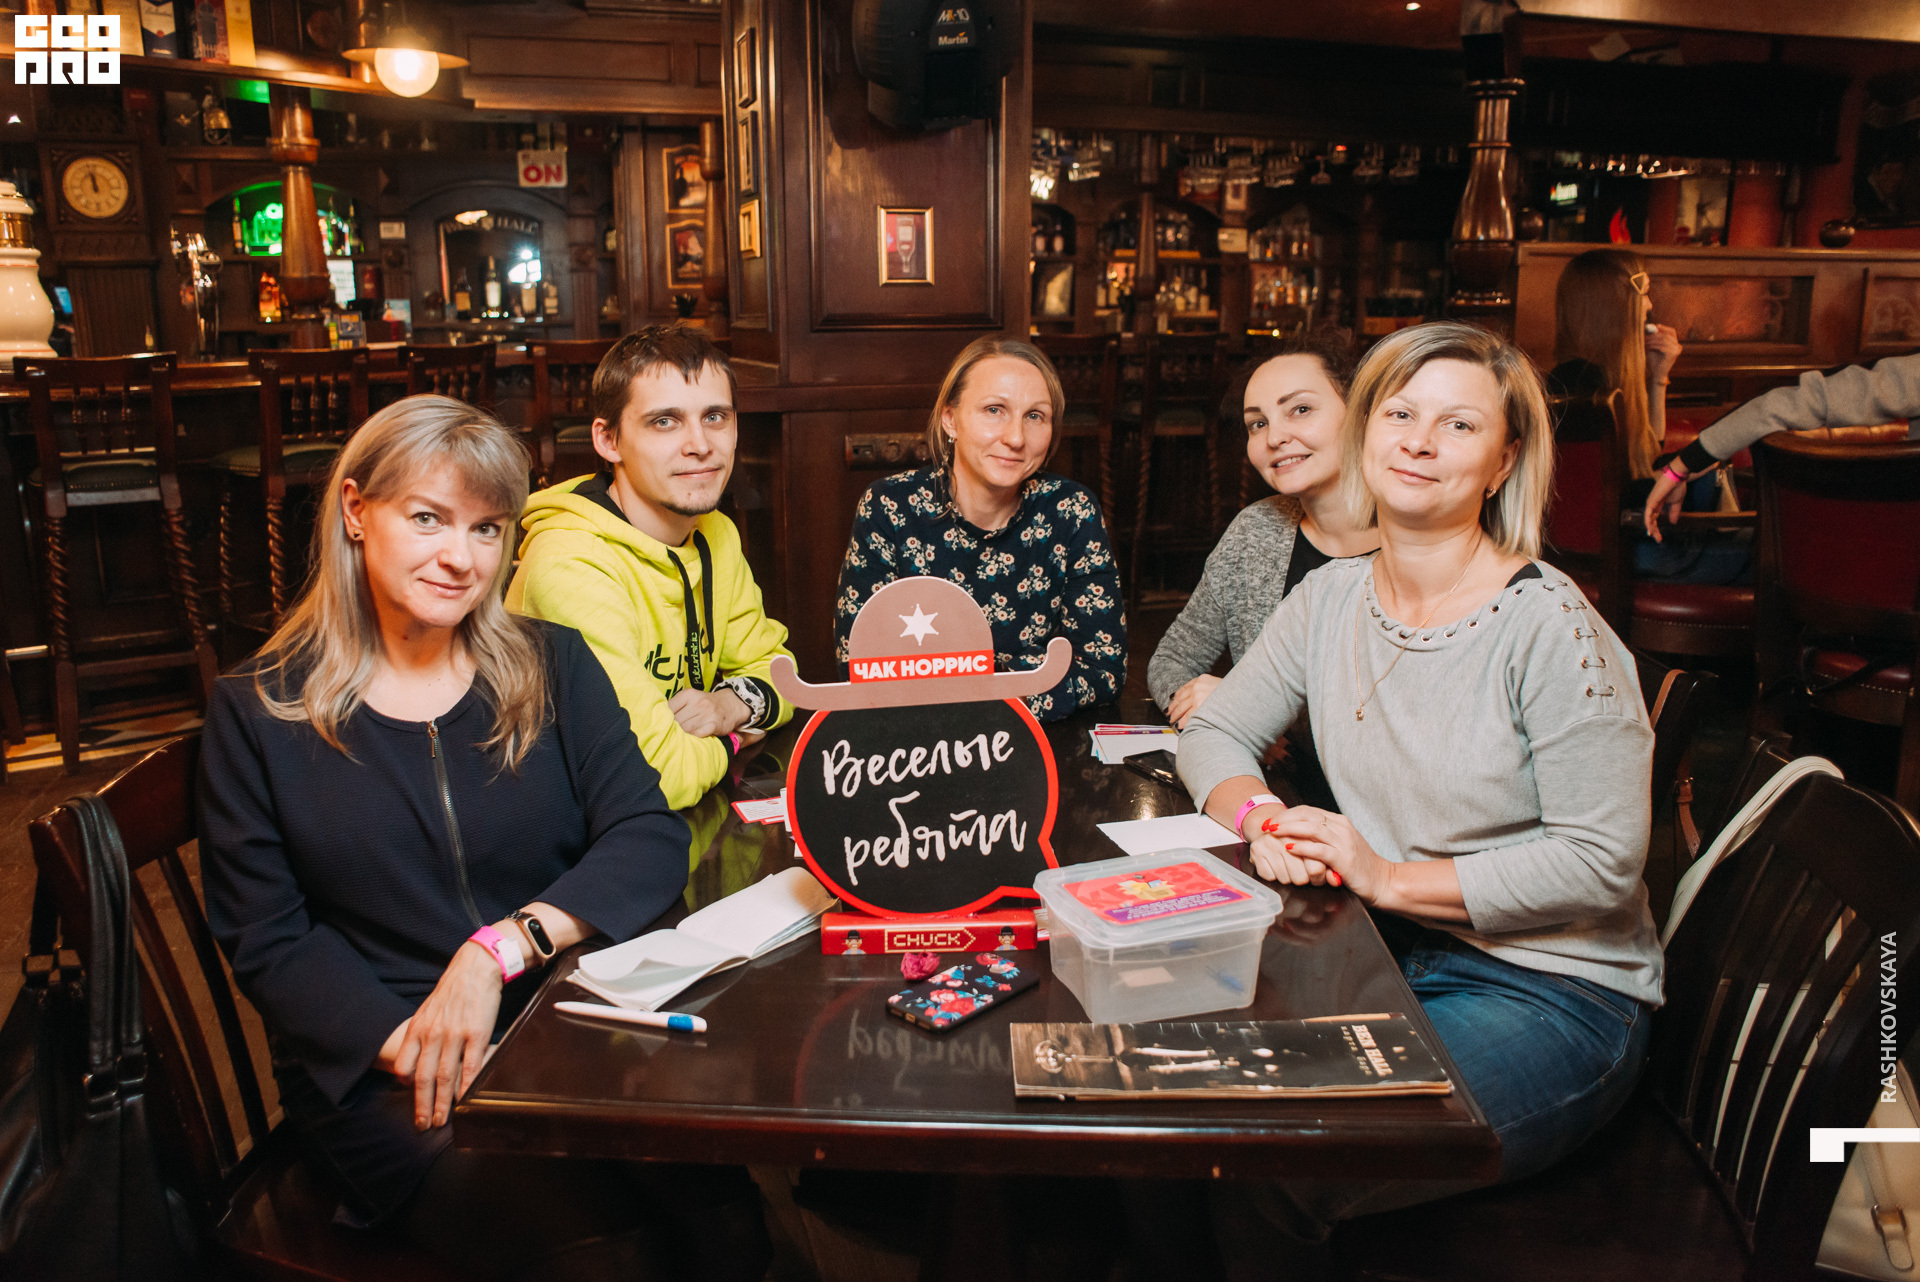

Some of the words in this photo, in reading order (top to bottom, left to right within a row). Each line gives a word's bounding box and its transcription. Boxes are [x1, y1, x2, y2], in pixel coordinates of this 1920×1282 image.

[937, 8, 970, 24] MX-10
[938, 32, 968, 46] Martin
[523, 165, 562, 183] ON
[854, 660, 897, 680] ЧАК
[901, 655, 988, 677] НОРРИС
[822, 731, 1014, 798] Веселые
[844, 790, 1027, 886] ребята
[893, 933, 961, 947] CHUCK
[1351, 1024, 1377, 1048] BEN
[1364, 1048, 1393, 1077] HALL
